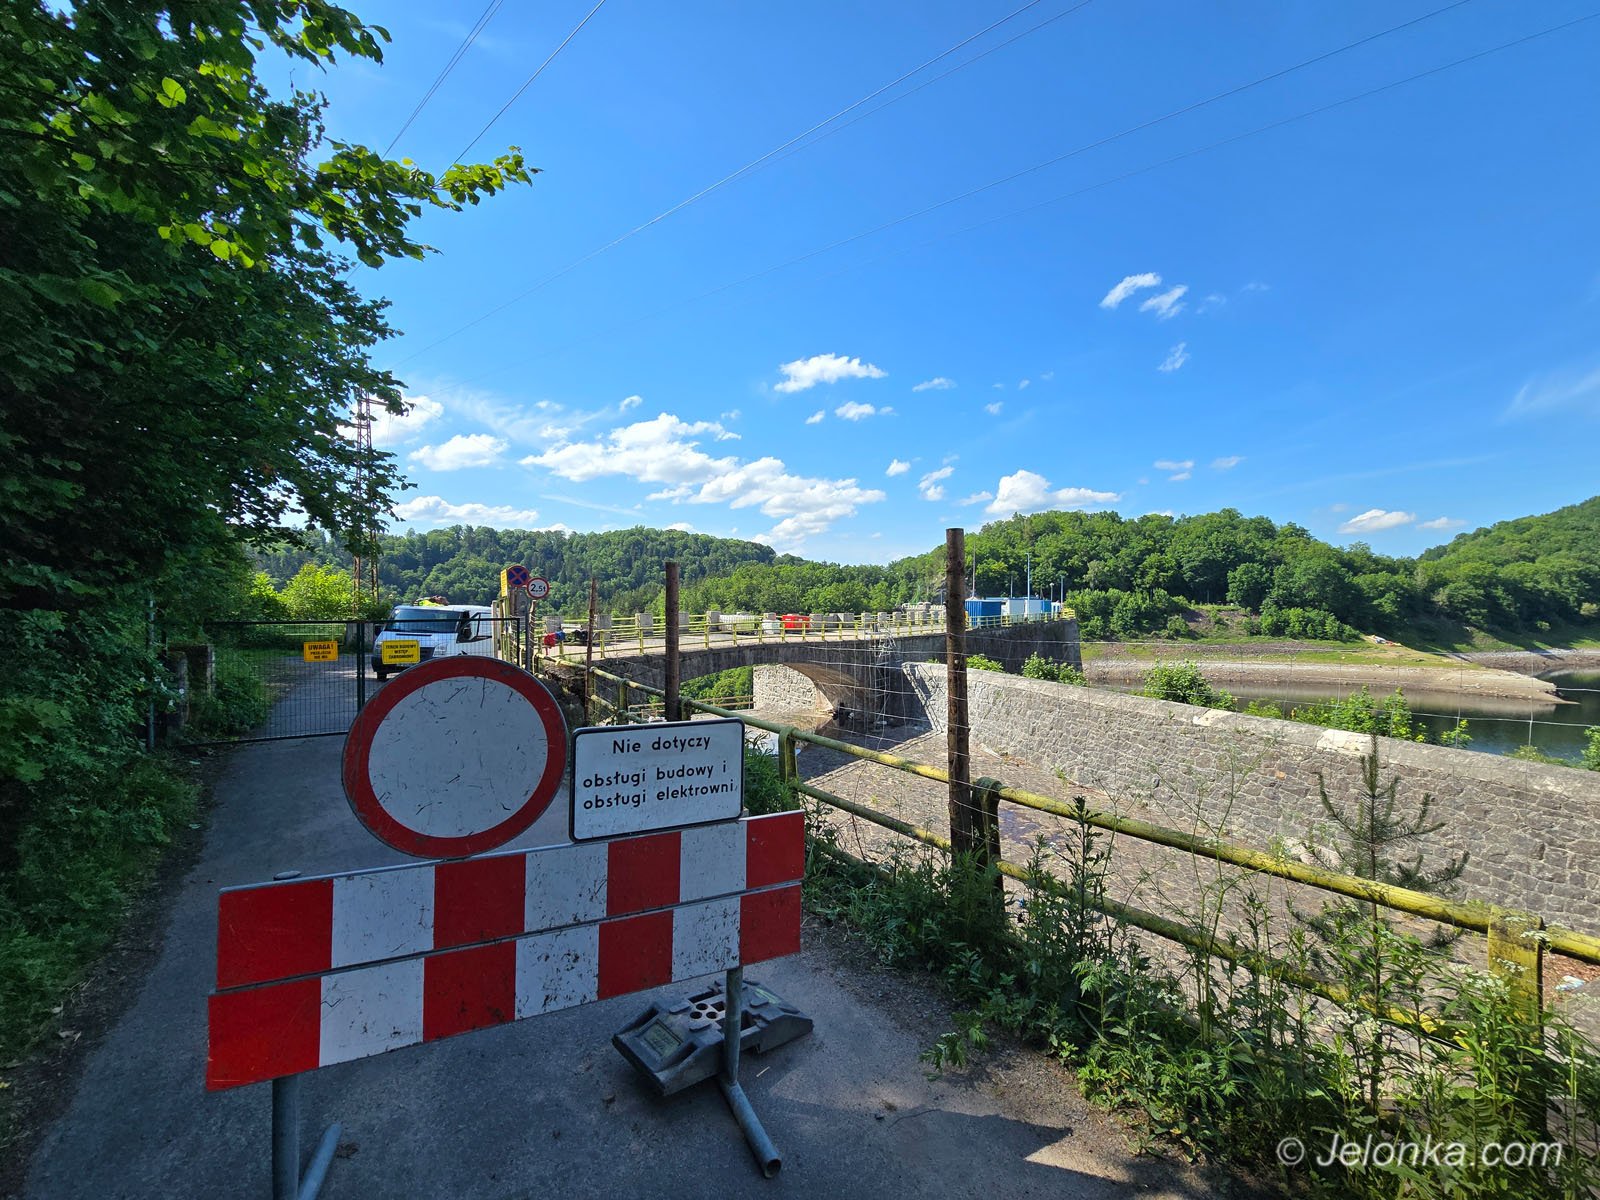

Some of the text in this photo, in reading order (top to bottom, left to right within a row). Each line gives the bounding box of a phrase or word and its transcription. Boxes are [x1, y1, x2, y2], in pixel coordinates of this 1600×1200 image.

[308, 643, 334, 651] UWAGA!
[612, 735, 711, 754] Nie dotyczy
[583, 760, 727, 788] obsługi budowy i
[583, 779, 734, 809] obsługi elektrowni
